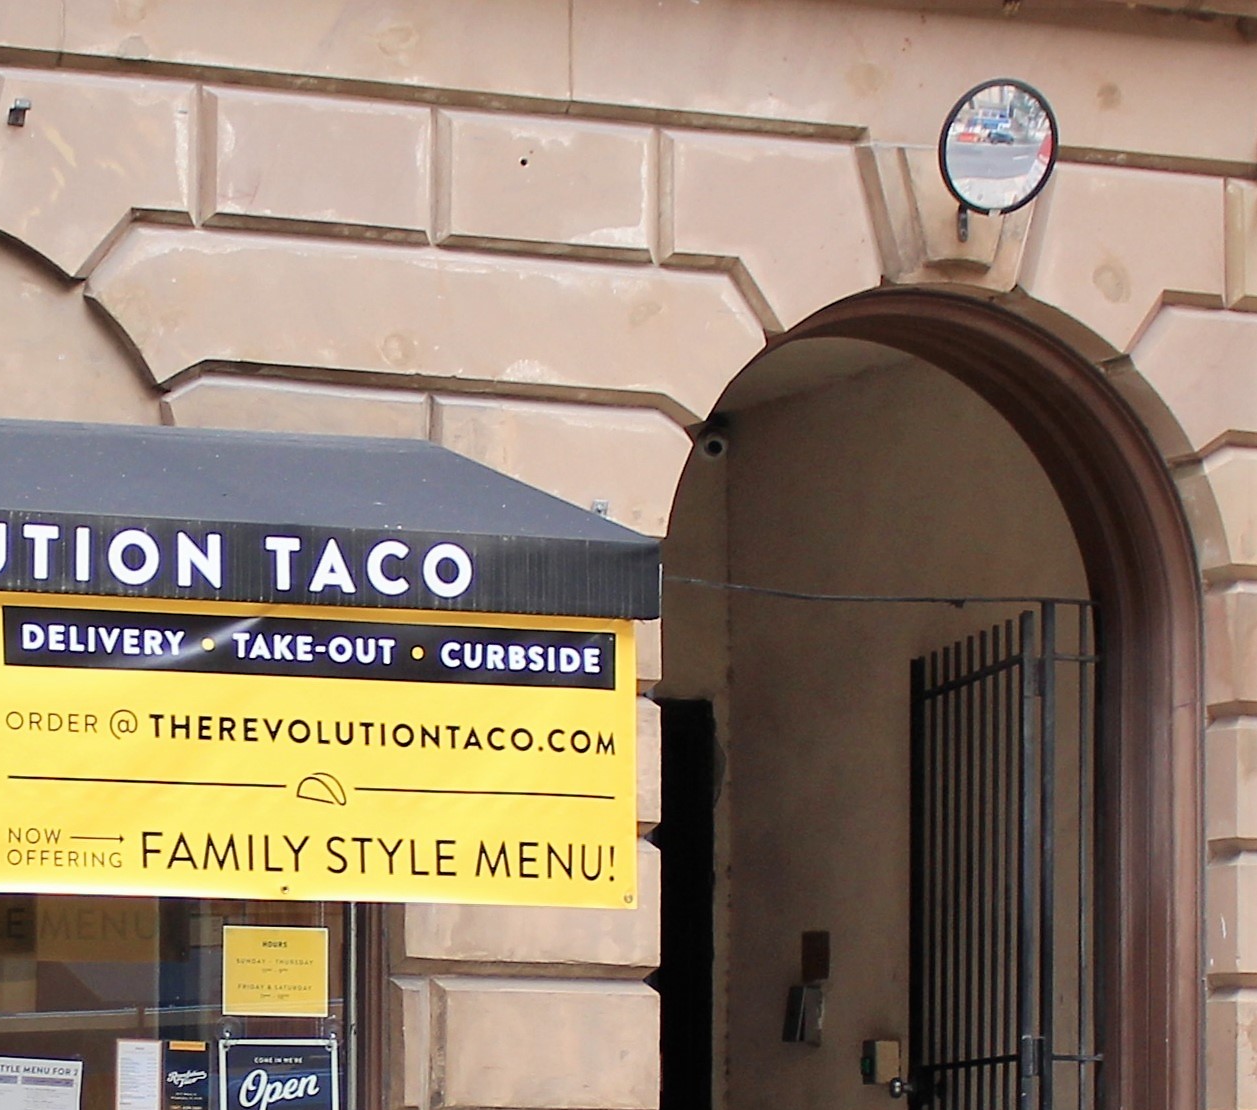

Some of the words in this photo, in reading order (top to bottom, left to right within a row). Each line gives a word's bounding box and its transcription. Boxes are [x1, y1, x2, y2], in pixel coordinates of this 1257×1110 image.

[265, 535, 475, 598] TACO
[21, 623, 186, 656] DELIVERY
[232, 632, 396, 665] TAKE-OUT
[440, 642, 601, 674] CURBSIDE
[5, 710, 99, 735] ORDER
[109, 708, 138, 739] @
[149, 713, 617, 757] THEREVOLUTIONTACO.COM
[7, 827, 62, 844] NOW
[6, 849, 123, 869] OFFERING
[142, 830, 311, 873] FAMILY
[326, 835, 458, 878] STYLE
[475, 841, 617, 883] MENU!
[23, 1066, 50, 1075] MENU
[52, 1067, 71, 1076] FOR
[254, 1056, 273, 1064] COME
